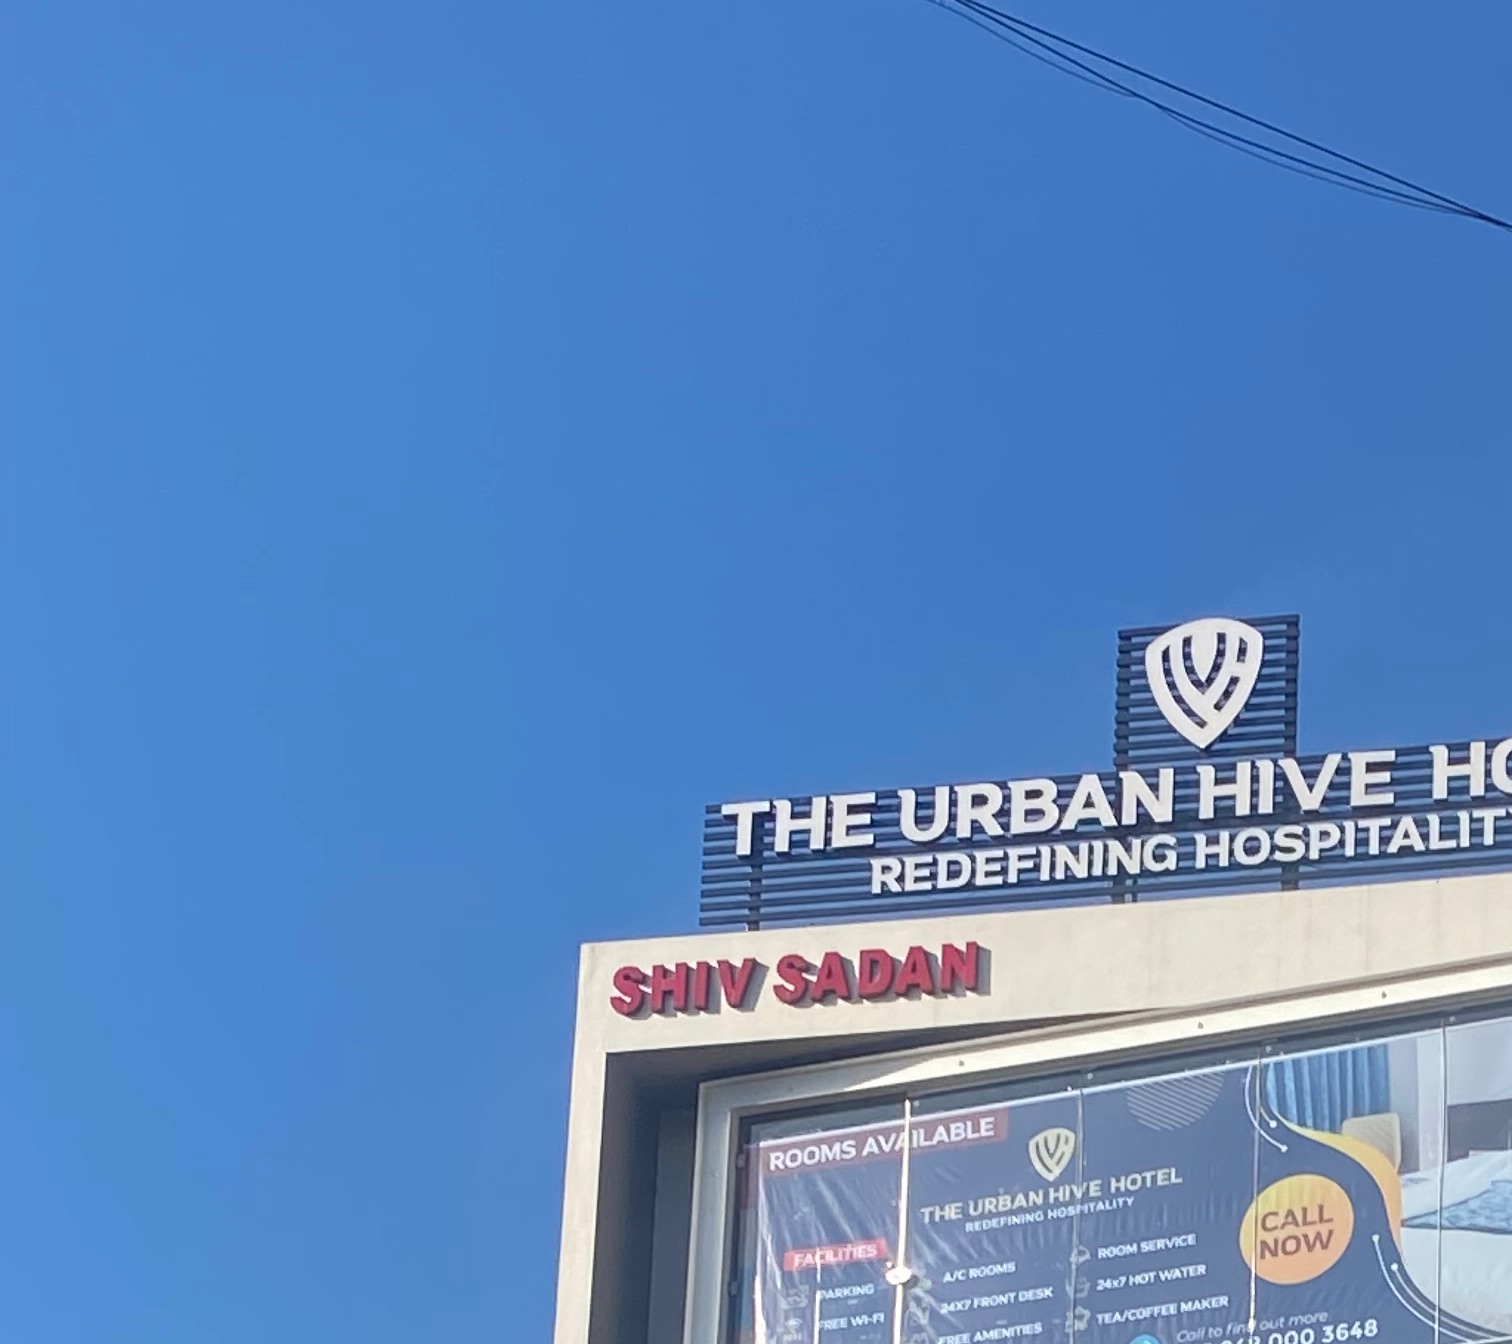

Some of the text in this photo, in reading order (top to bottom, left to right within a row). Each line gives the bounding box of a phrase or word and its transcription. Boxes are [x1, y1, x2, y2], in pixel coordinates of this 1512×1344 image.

[722, 792, 876, 856] THE
[898, 766, 1176, 843] URBAN
[1197, 749, 1397, 820] HIVE
[870, 838, 1177, 894] REDEFINING
[610, 940, 984, 1017] SHIV SADAN
[769, 1116, 995, 1172] ROOMS AVAILABLE
[920, 1167, 1183, 1225] THE URBAN HIVE HOTEL
[965, 1195, 1135, 1233] REDEFINING HOSPITALITY
[1259, 1203, 1335, 1233] CALL
[794, 1244, 877, 1268] FACILITIES
[1098, 1234, 1197, 1260] ROOM SERVICE
[1258, 1228, 1336, 1261] NOW
[943, 1261, 1016, 1284] A/C ROOMS
[1129, 1271, 1157, 1287] HOT
[1158, 1264, 1207, 1282] WATER
[973, 1291, 1017, 1309] FRONT
[1018, 1286, 1054, 1302] DESK
[1096, 1295, 1229, 1325] TEA/COFFEE MAKER
[851, 1312, 885, 1327] WI-FI
[973, 1321, 1043, 1343] AMENITIES
[1176, 1311, 1328, 1344] Call to fin out more
[1321, 1318, 1379, 1344] 3648
